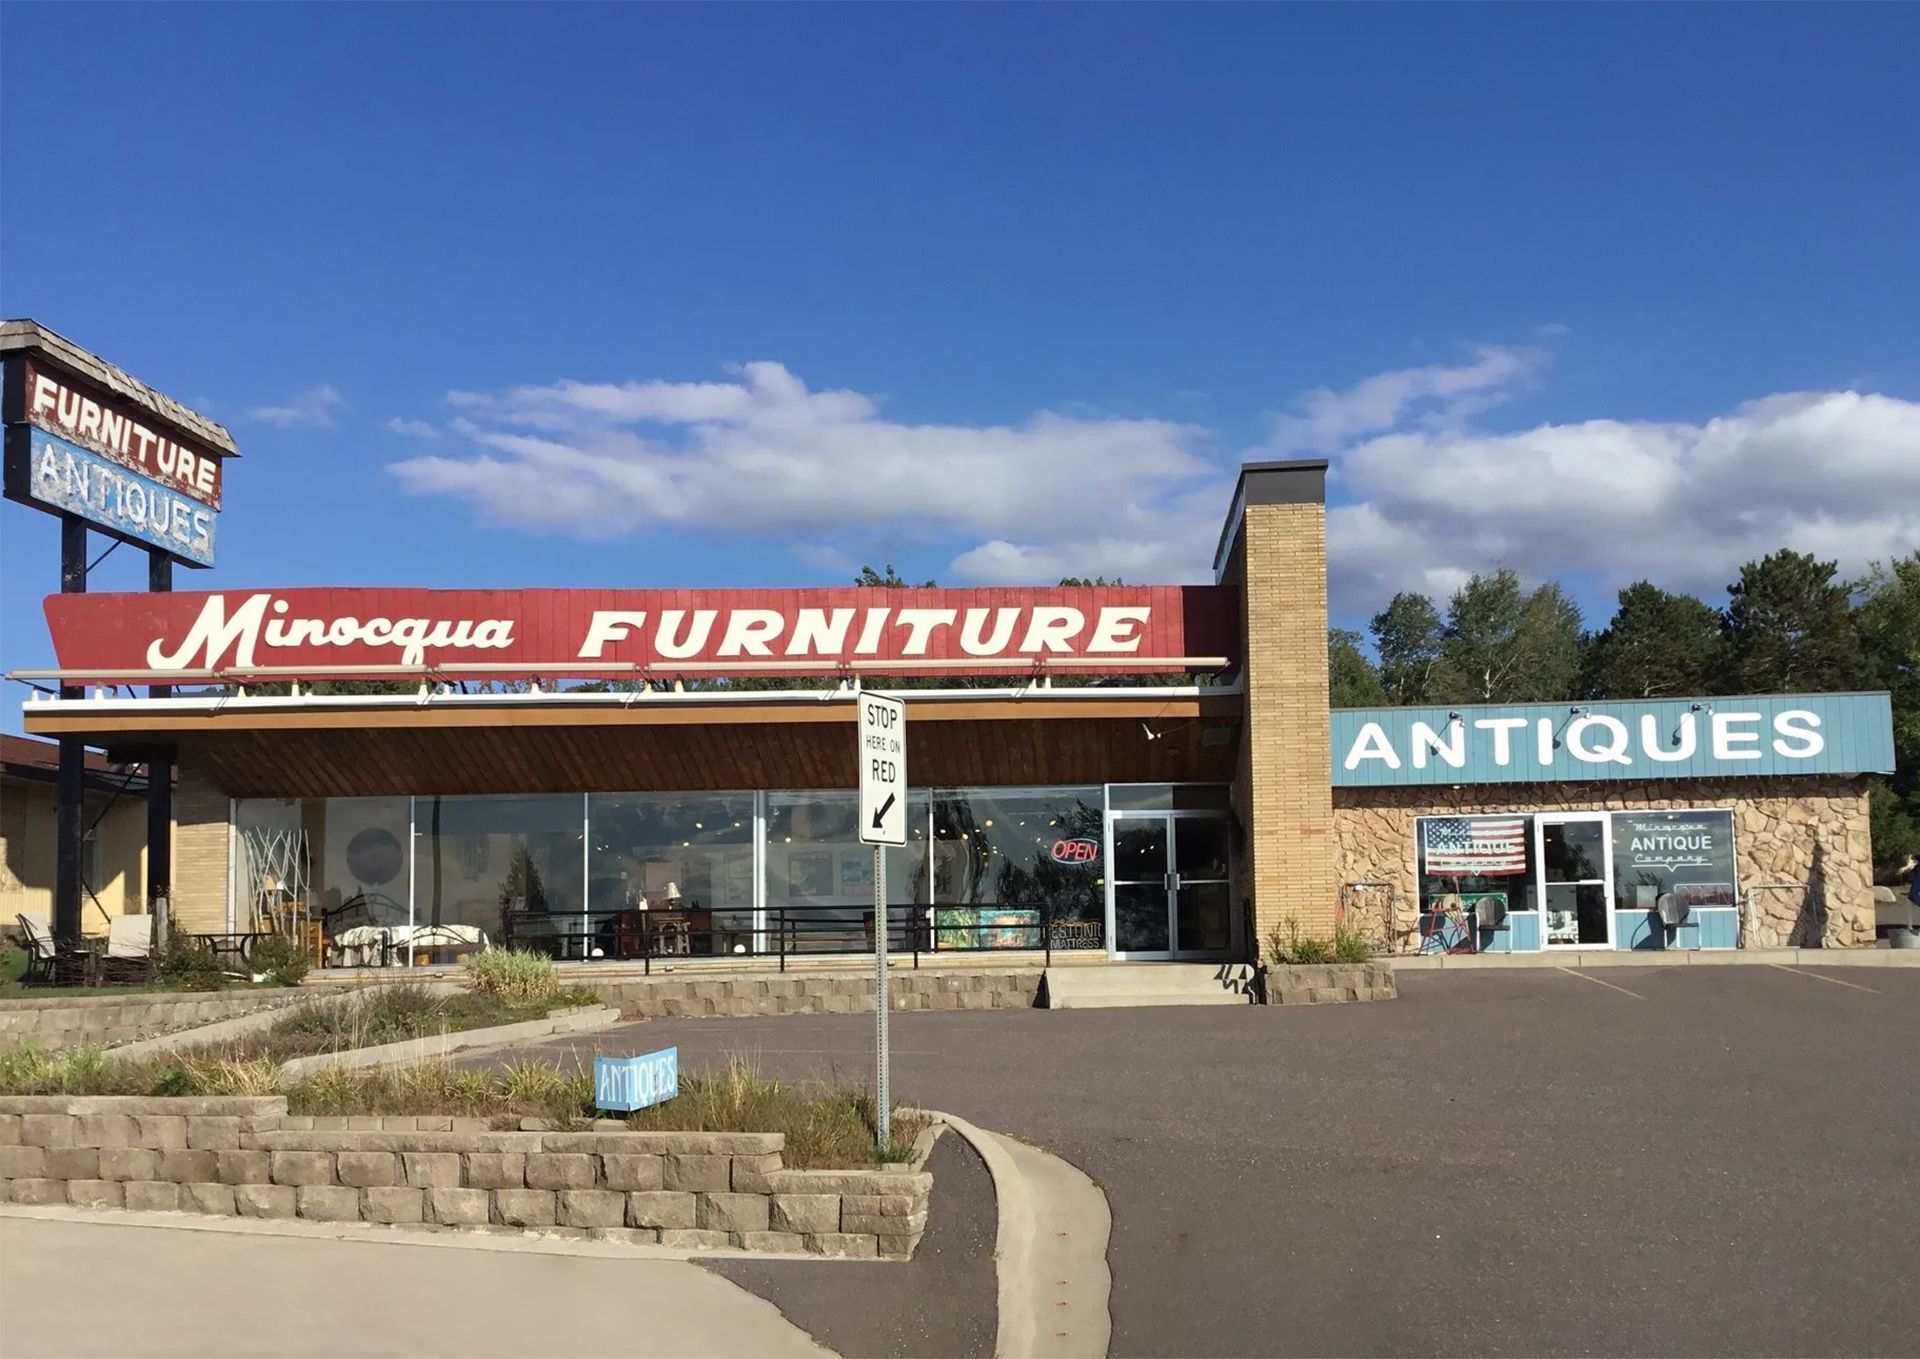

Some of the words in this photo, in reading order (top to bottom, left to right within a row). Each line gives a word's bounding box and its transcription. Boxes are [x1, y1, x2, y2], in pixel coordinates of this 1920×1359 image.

[34, 374, 216, 493] FURNITURE
[40, 444, 210, 548] ANTIQUES
[146, 593, 515, 674] Minocqua
[576, 606, 1153, 659] FURNITURE
[868, 703, 898, 730] STOP
[866, 734, 886, 751] HERE
[889, 739, 901, 754] ON
[1343, 709, 1825, 771] ANTIQUES
[872, 758, 896, 783] RED
[1052, 840, 1098, 861] OPEN
[1436, 841, 1516, 856] ANTIQUE
[1630, 835, 1713, 852] ANTIQUE
[1634, 853, 1709, 864] Company
[600, 1056, 676, 1107] ANTIQUES
